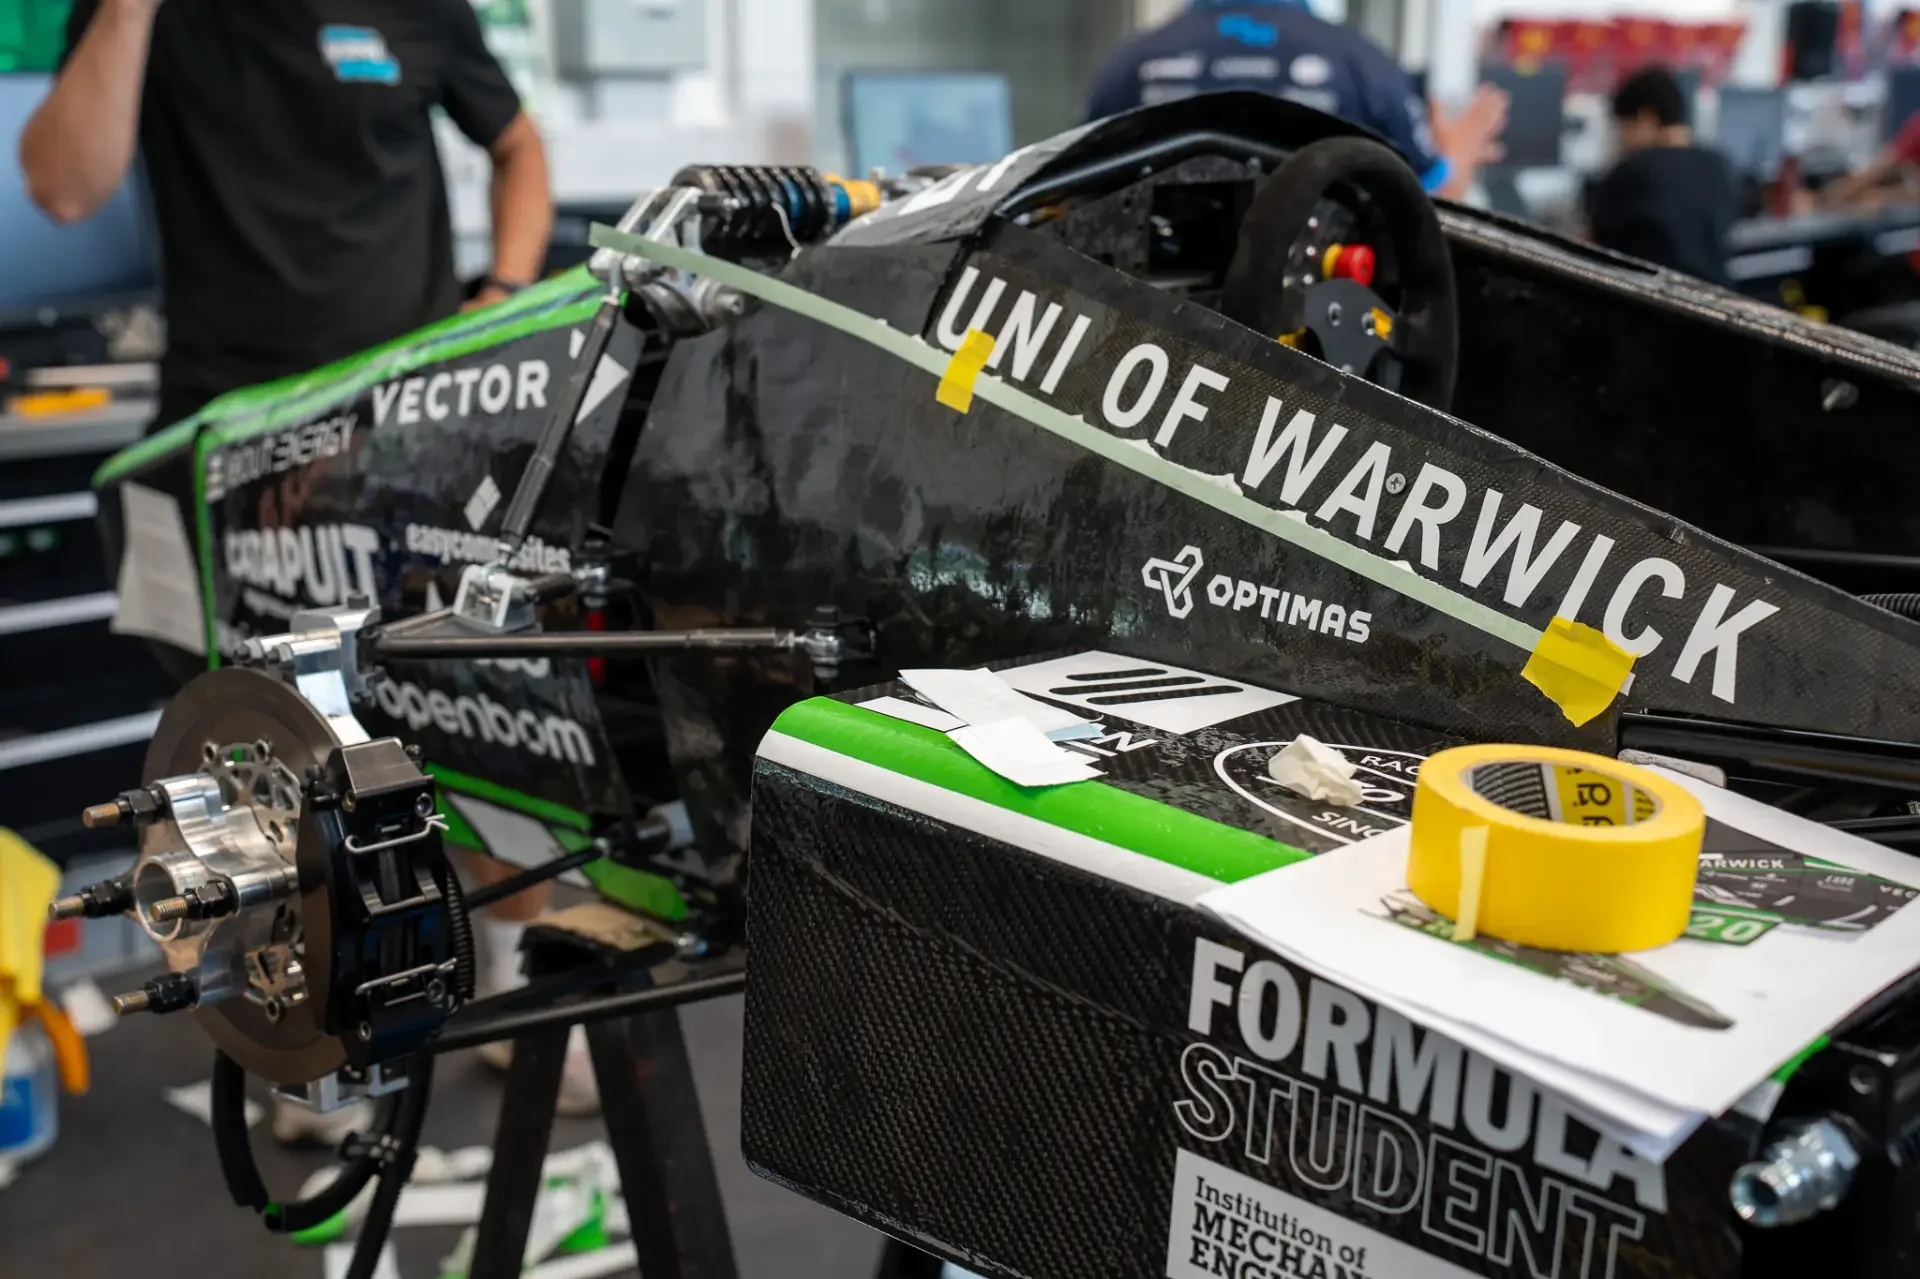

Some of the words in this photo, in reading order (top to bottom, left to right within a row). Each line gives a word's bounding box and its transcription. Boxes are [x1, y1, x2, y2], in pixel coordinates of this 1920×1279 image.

[372, 359, 550, 427] VECTOR
[936, 266, 1091, 394] UNI
[1102, 343, 1229, 447] OF
[1242, 396, 1780, 704] WARWICK
[1206, 573, 1372, 644] OPTIMAS
[1699, 858, 1785, 869] ARWICK
[1689, 912, 1764, 942] 20
[1188, 937, 1667, 1213] FORMULA
[1173, 1042, 1645, 1279] STUDENT
[1195, 1175, 1332, 1257] Institution
[1338, 1244, 1367, 1270] of
